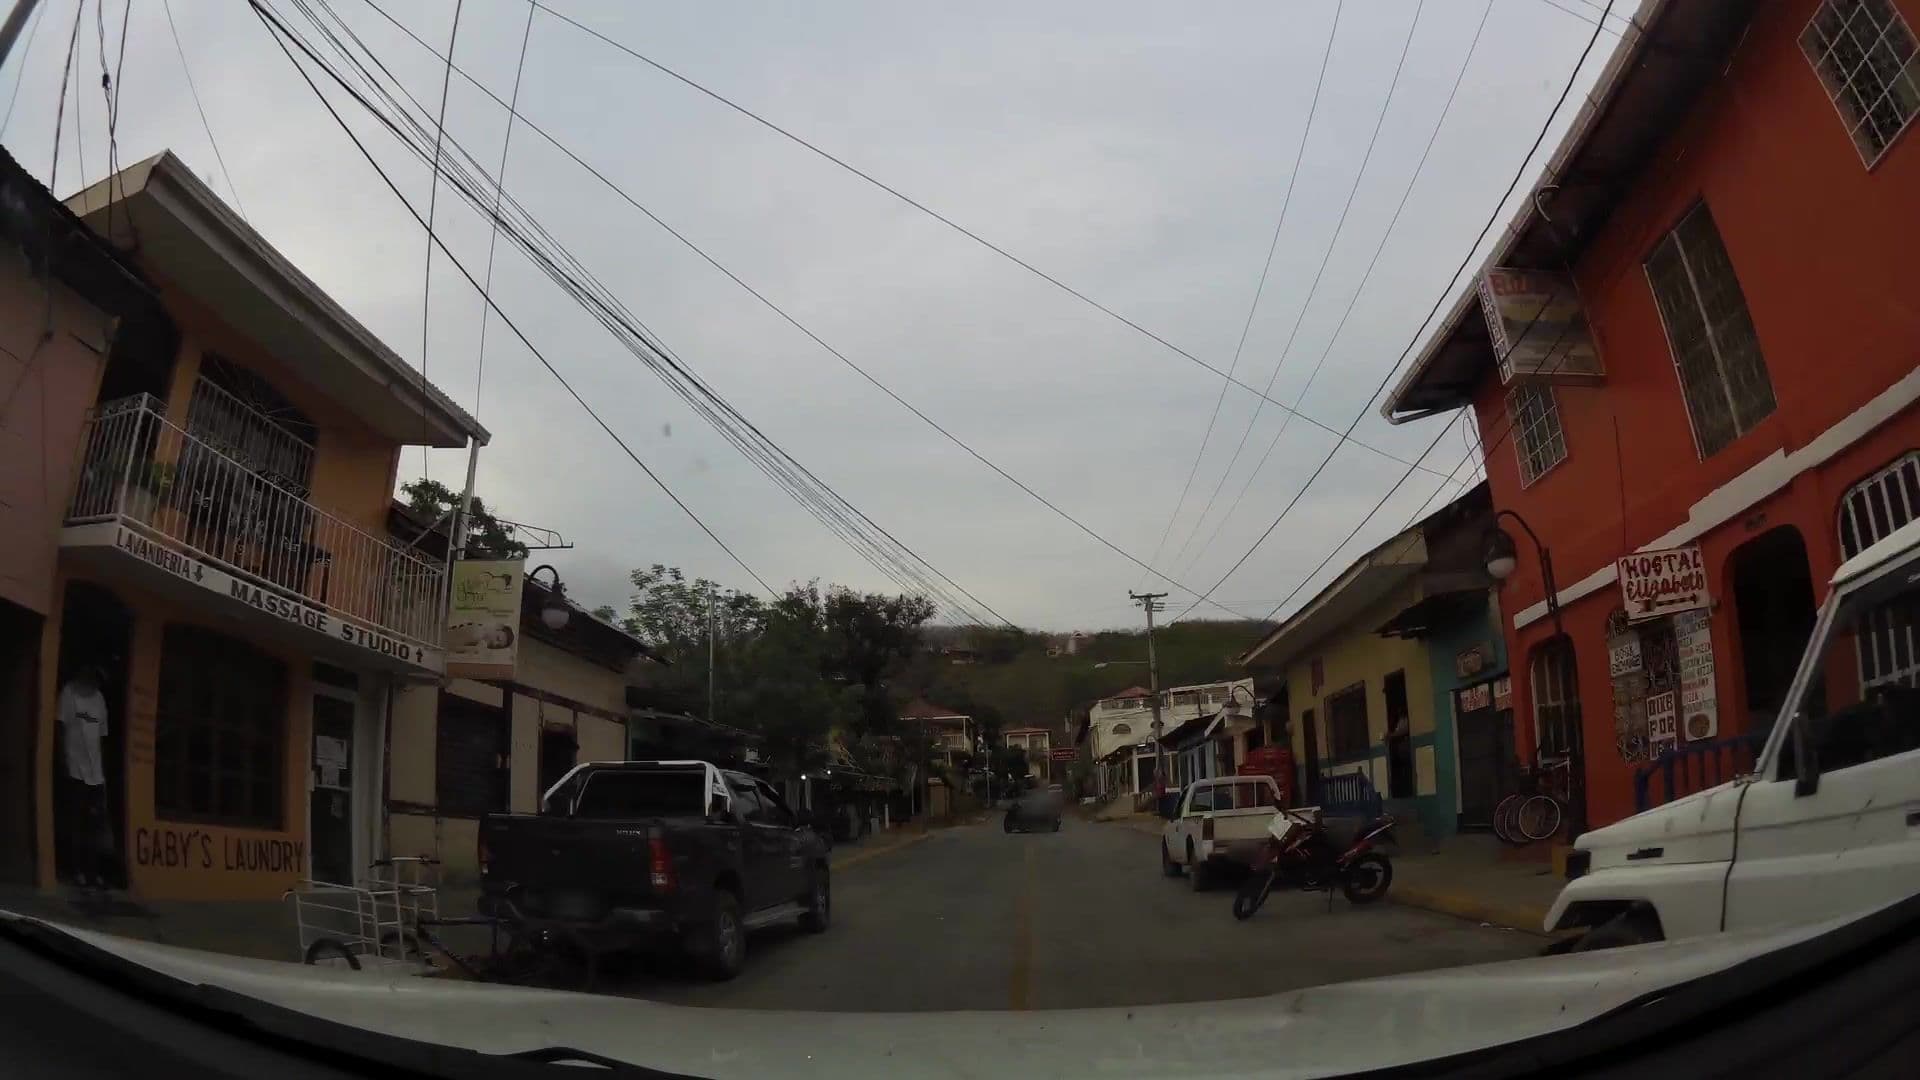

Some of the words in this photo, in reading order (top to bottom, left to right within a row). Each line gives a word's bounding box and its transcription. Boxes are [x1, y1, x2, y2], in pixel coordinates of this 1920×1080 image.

[115, 526, 191, 579] LAVANDERIA
[1621, 550, 1701, 579] HOSTAL
[230, 578, 328, 632] MASSAGE
[340, 623, 410, 661] STUDIO
[1649, 716, 1675, 736] FOR
[136, 827, 213, 868] GABY'S
[223, 834, 305, 873] LAUNDRY
